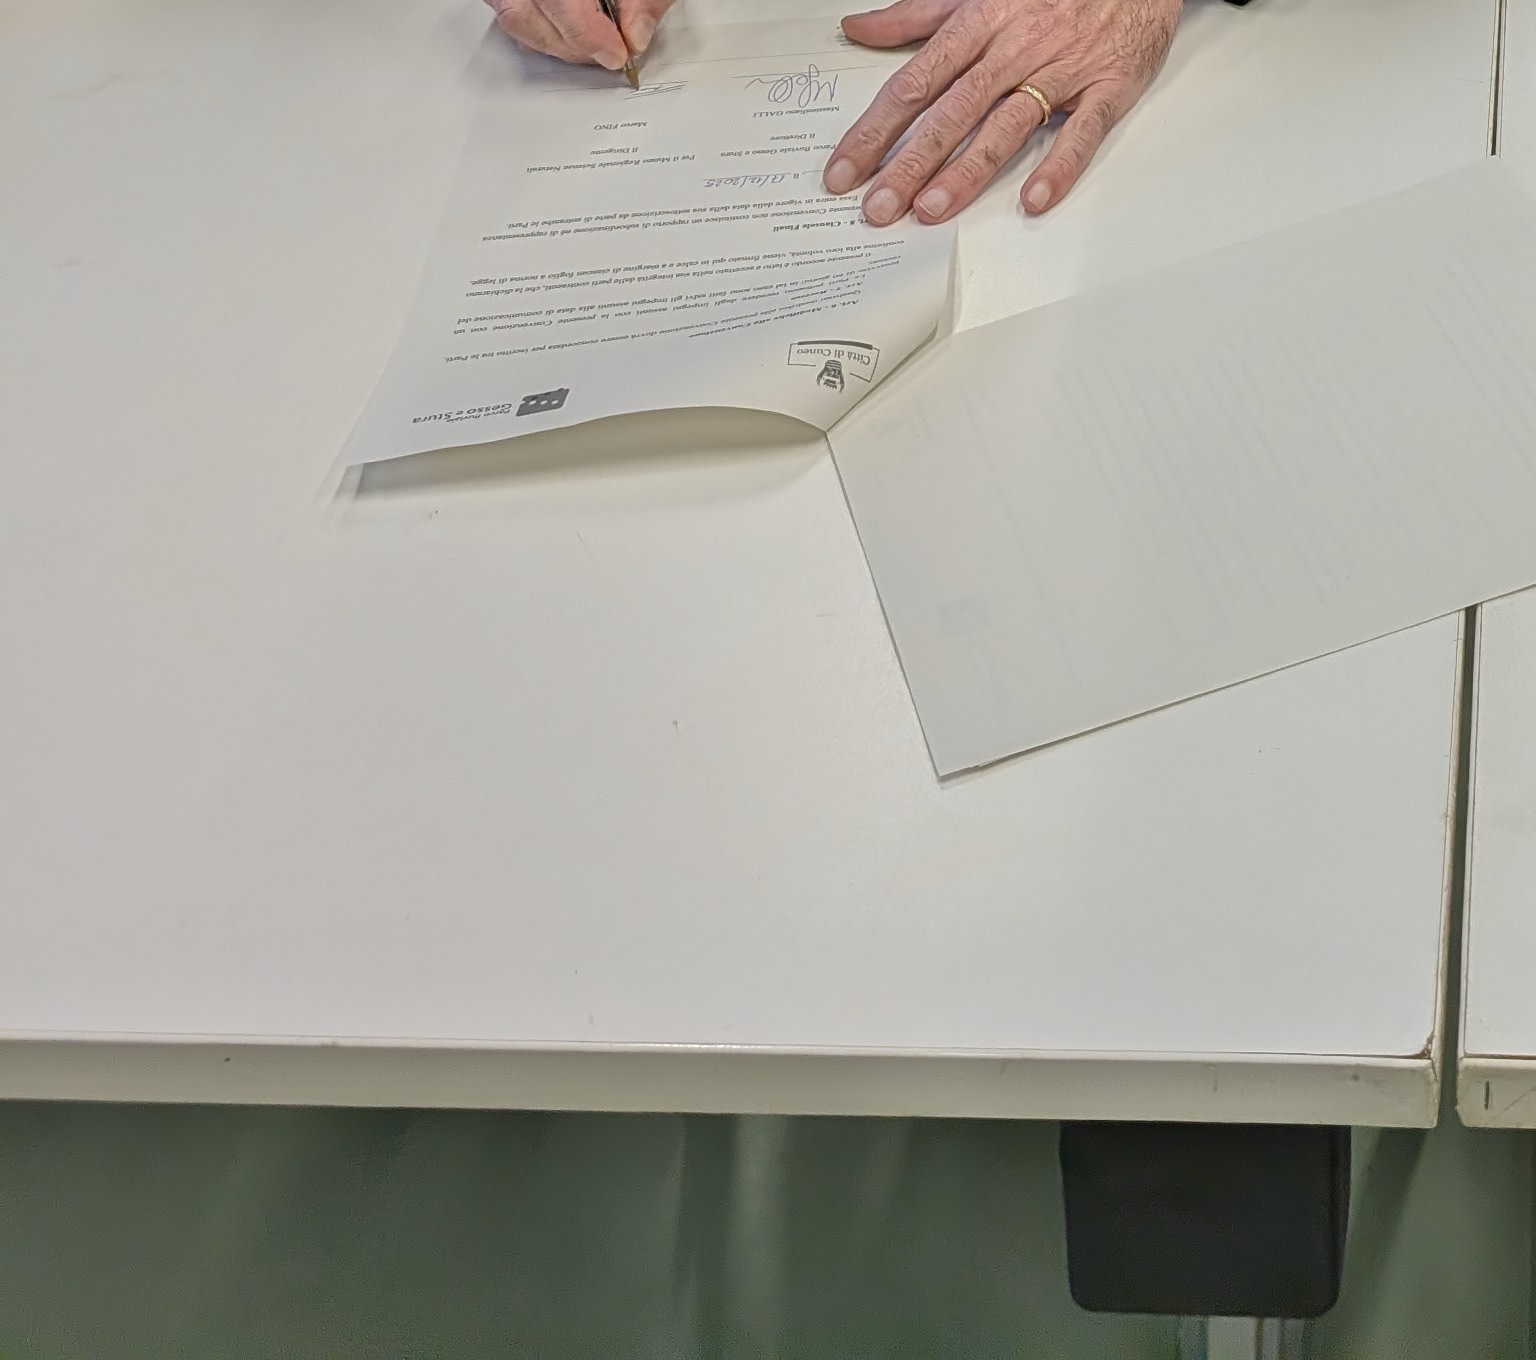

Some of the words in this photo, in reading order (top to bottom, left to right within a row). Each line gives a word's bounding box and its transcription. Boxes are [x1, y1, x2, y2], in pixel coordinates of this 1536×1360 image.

[753, 110, 783, 118] GALLI
[785, 105, 840, 115] Massimiliano
[593, 123, 618, 131] FINO
[769, 133, 808, 141] Direttore
[590, 147, 630, 156] Dirigente
[779, 145, 811, 154] fluviale
[597, 159, 640, 169] Regionale
[642, 156, 671, 164] Museo
[526, 165, 562, 174] Naturali
[563, 162, 597, 170] Scienze
[772, 224, 800, 233] Finali
[796, 348, 832, 357] Cuneo
[834, 349, 845, 358] di
[847, 351, 871, 366] Città
[466, 403, 513, 415] Gesso
[483, 408, 511, 418] Parco
[412, 411, 453, 424] Stura
